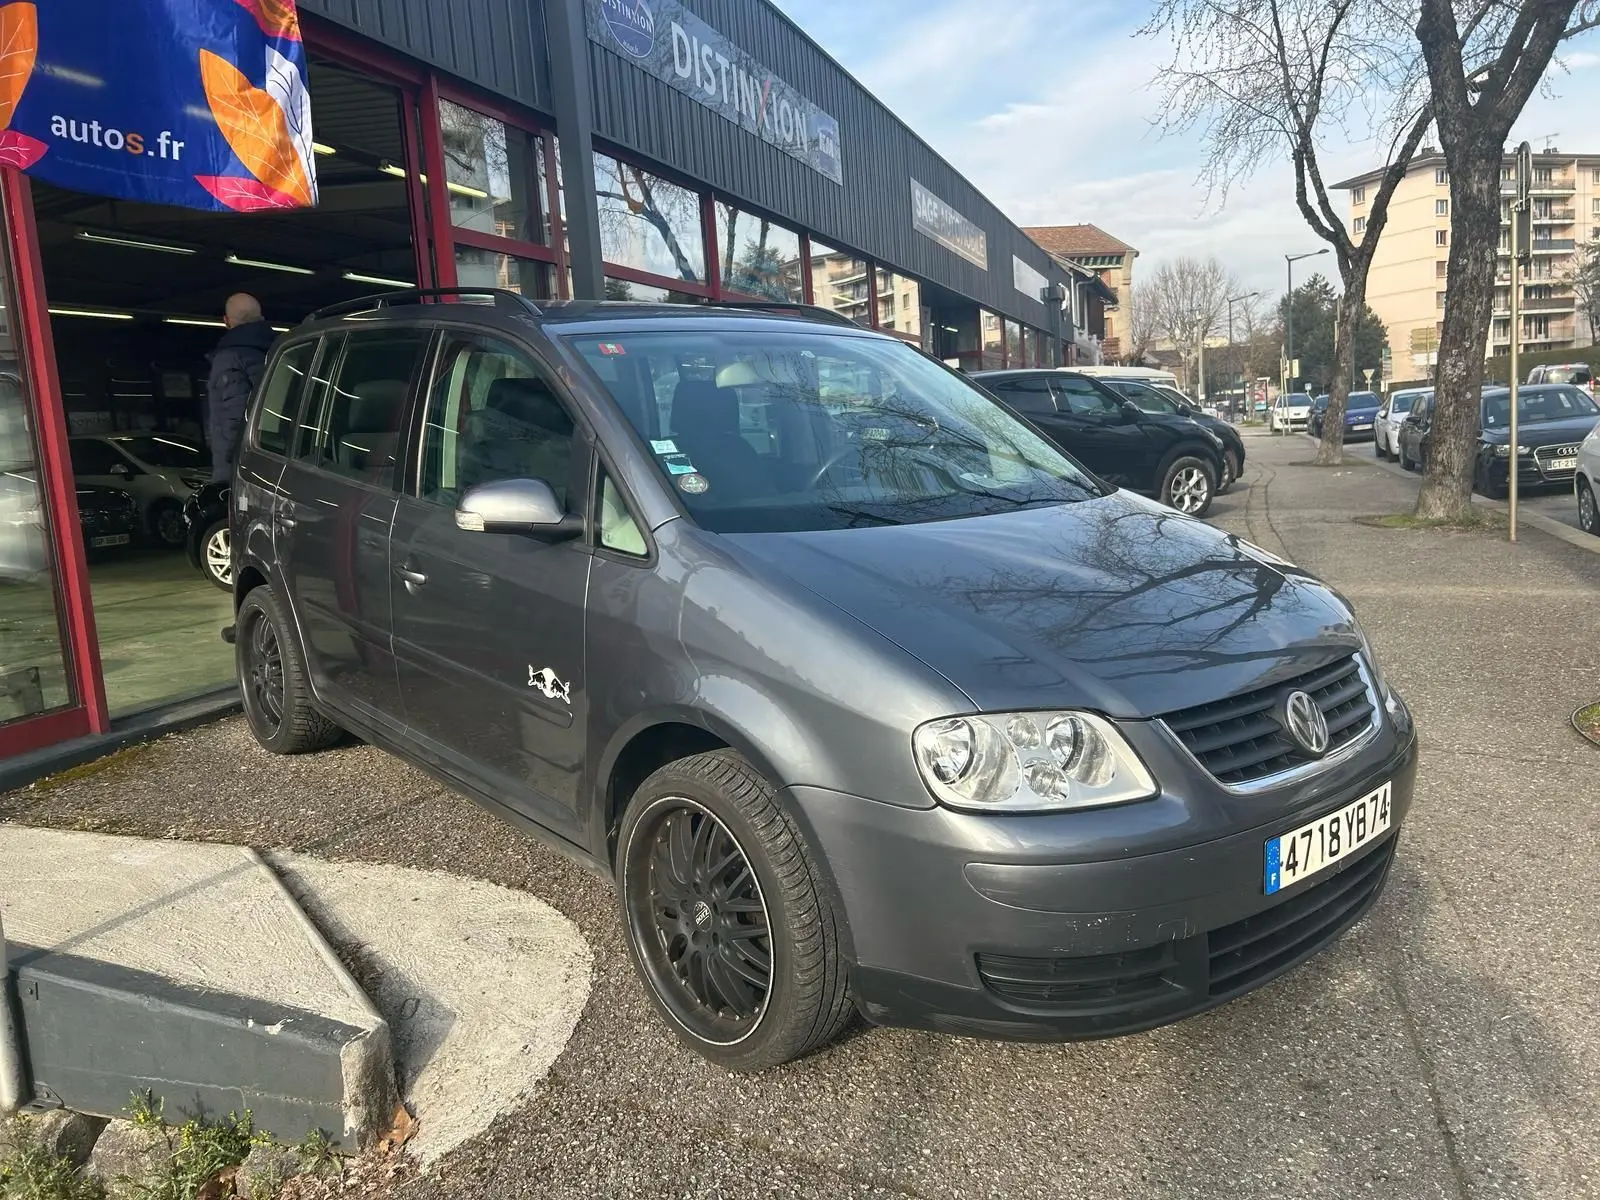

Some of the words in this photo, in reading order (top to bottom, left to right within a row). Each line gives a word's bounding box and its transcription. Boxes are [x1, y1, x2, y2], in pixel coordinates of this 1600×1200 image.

[601, 0, 653, 33] ISTINXION
[671, 21, 808, 153] DISTINXION
[51, 114, 185, 161] autos.fr
[1270, 872, 1277, 886] F
